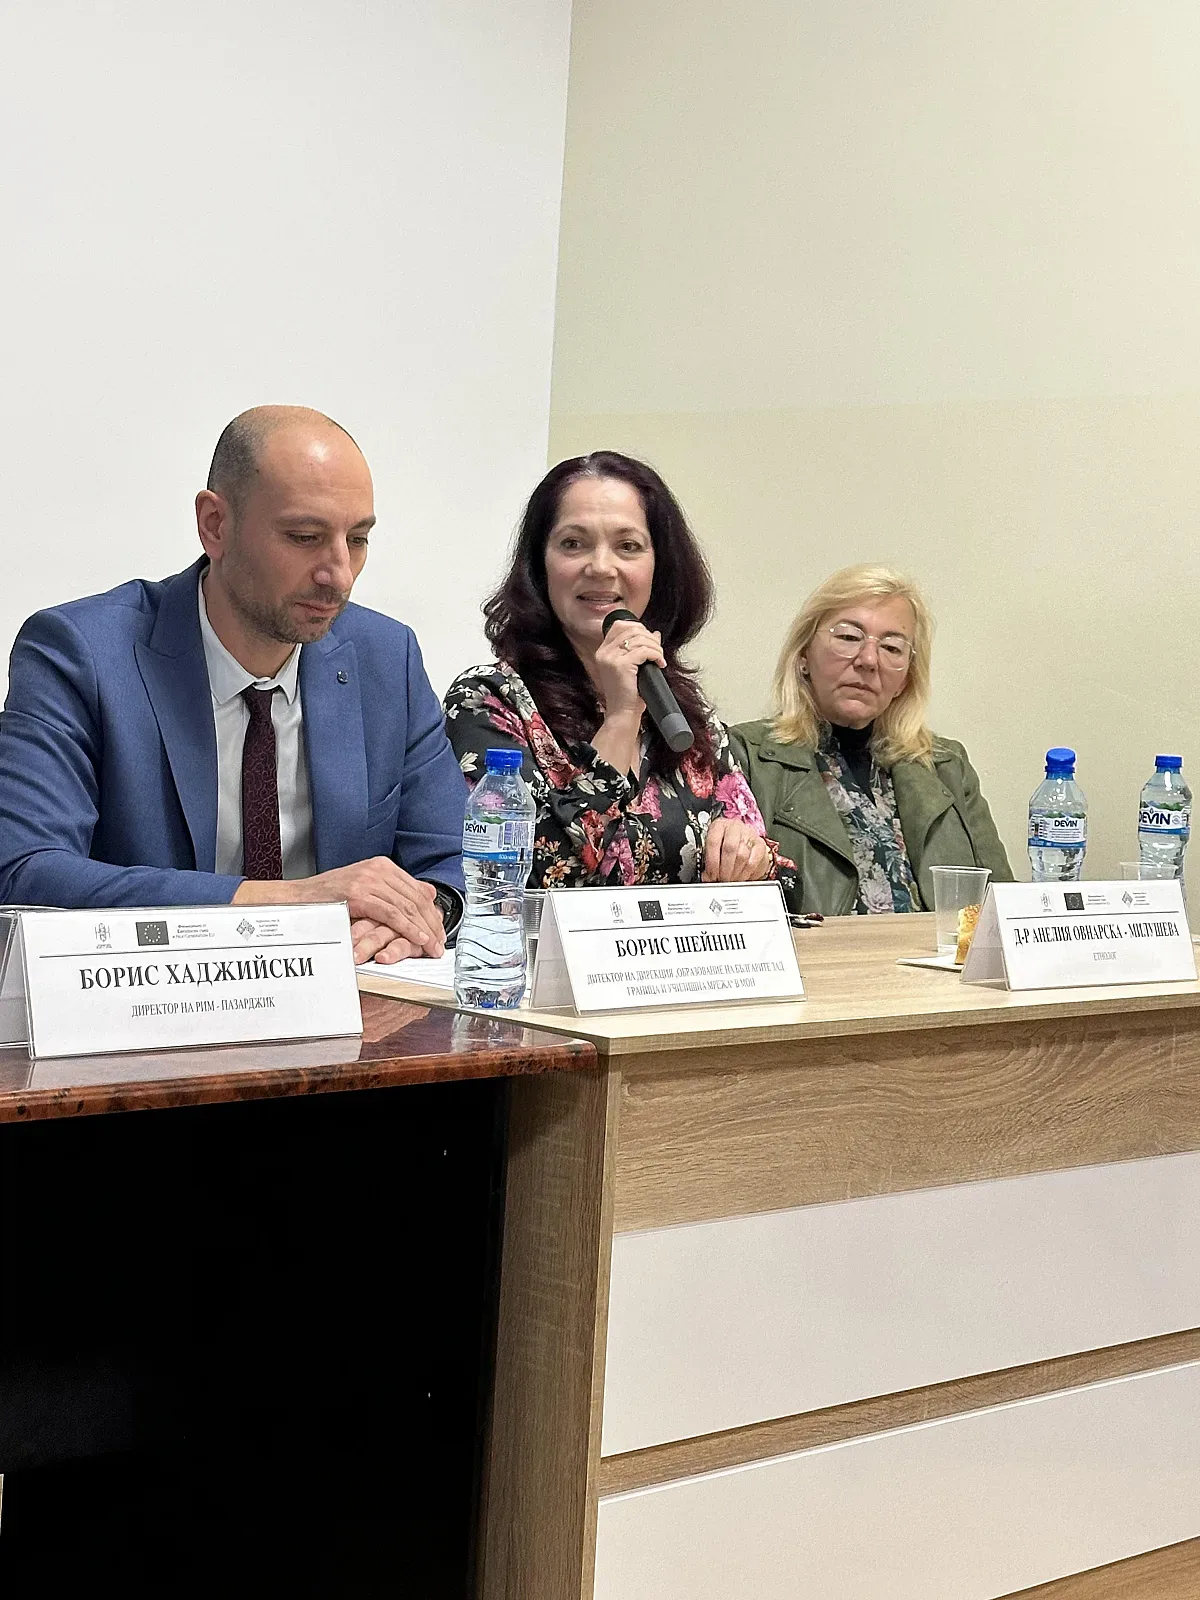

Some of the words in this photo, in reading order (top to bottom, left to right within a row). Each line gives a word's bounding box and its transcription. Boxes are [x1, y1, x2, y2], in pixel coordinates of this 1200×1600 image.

[465, 823, 487, 834] DEVIN
[1032, 926, 1072, 943] АНЕЛИЯ
[1072, 924, 1123, 940] ОВНАРСКА
[1128, 921, 1180, 938] МИЛУШЕВА
[615, 937, 672, 958] БОРИС
[674, 931, 747, 954] ШЕЙНИН
[79, 964, 160, 989] БОРИС
[166, 954, 314, 987] ХАДЖИЙСКИ
[131, 1002, 179, 1018] ДИРЕКТОР
[181, 1002, 194, 1014] НА
[195, 1000, 215, 1013] РИМ
[221, 996, 275, 1011] ПАЗАРДЖИК
